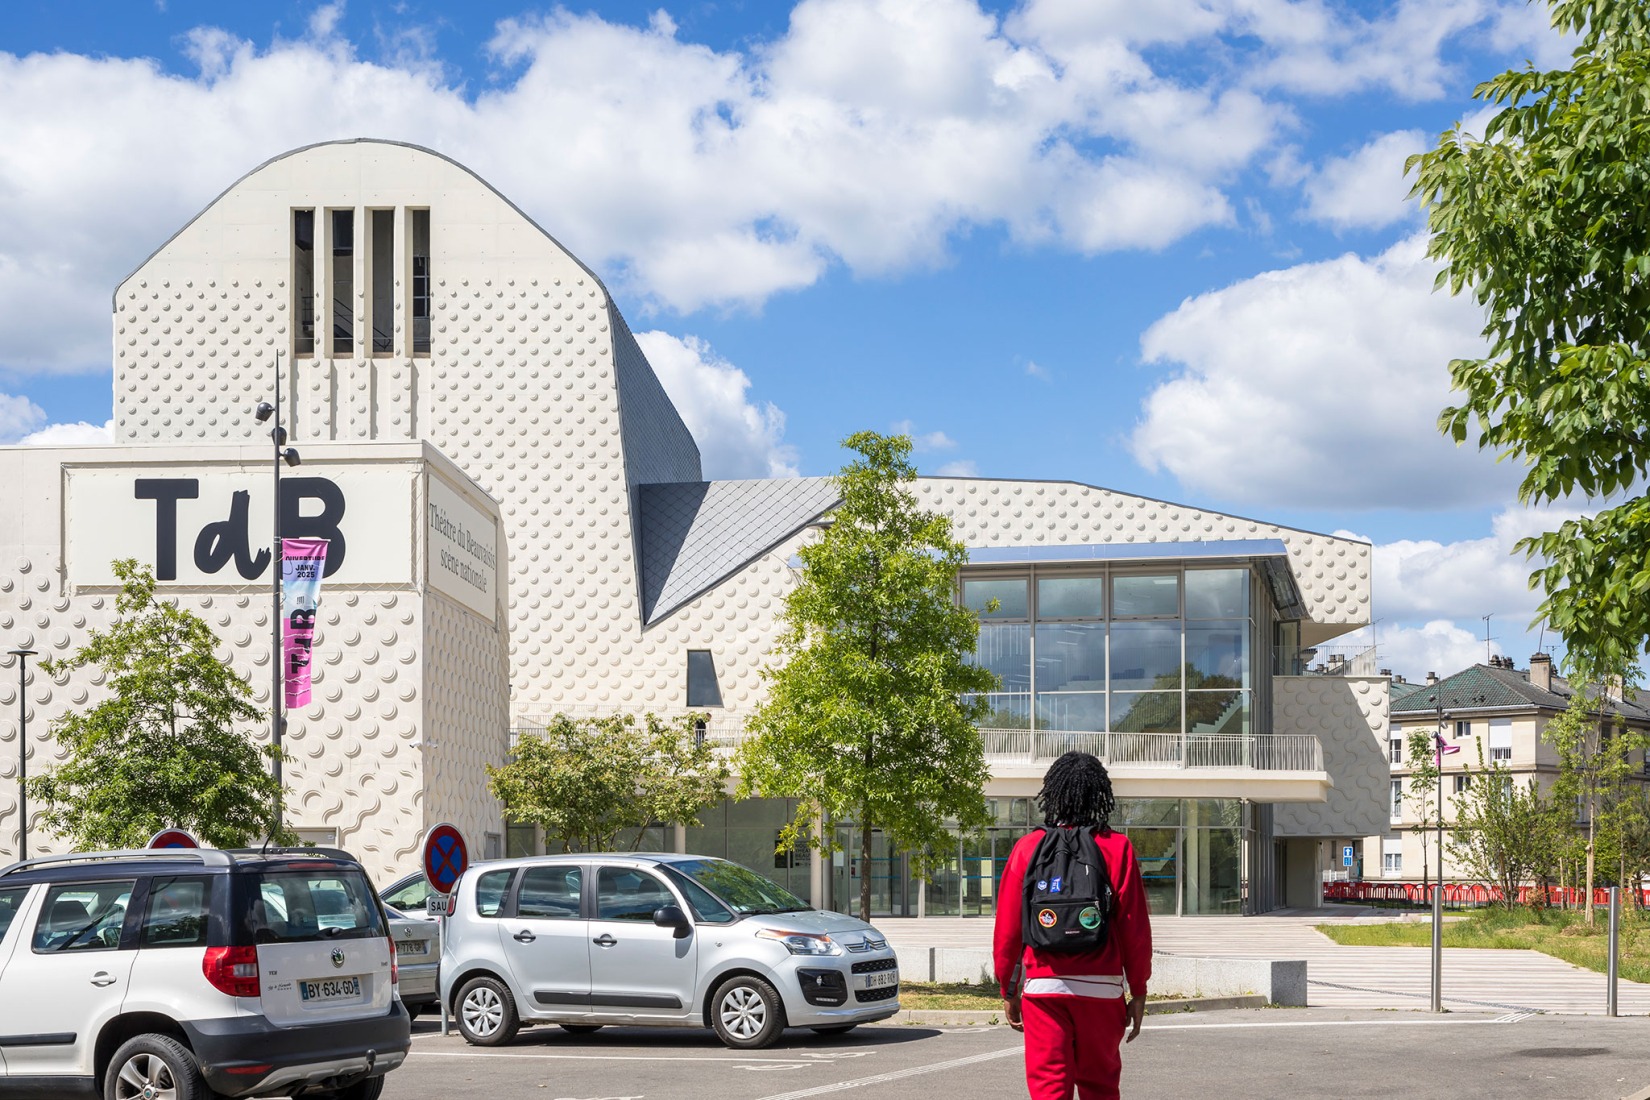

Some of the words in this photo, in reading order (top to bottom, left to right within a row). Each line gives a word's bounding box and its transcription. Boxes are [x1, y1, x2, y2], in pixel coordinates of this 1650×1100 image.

[135, 477, 346, 581] TdB
[430, 503, 456, 542] Théâtre
[457, 522, 466, 550] du
[466, 530, 495, 570] Beauvaisis
[440, 545, 459, 576] scène
[460, 561, 487, 593] nationale
[431, 901, 447, 911] SAU
